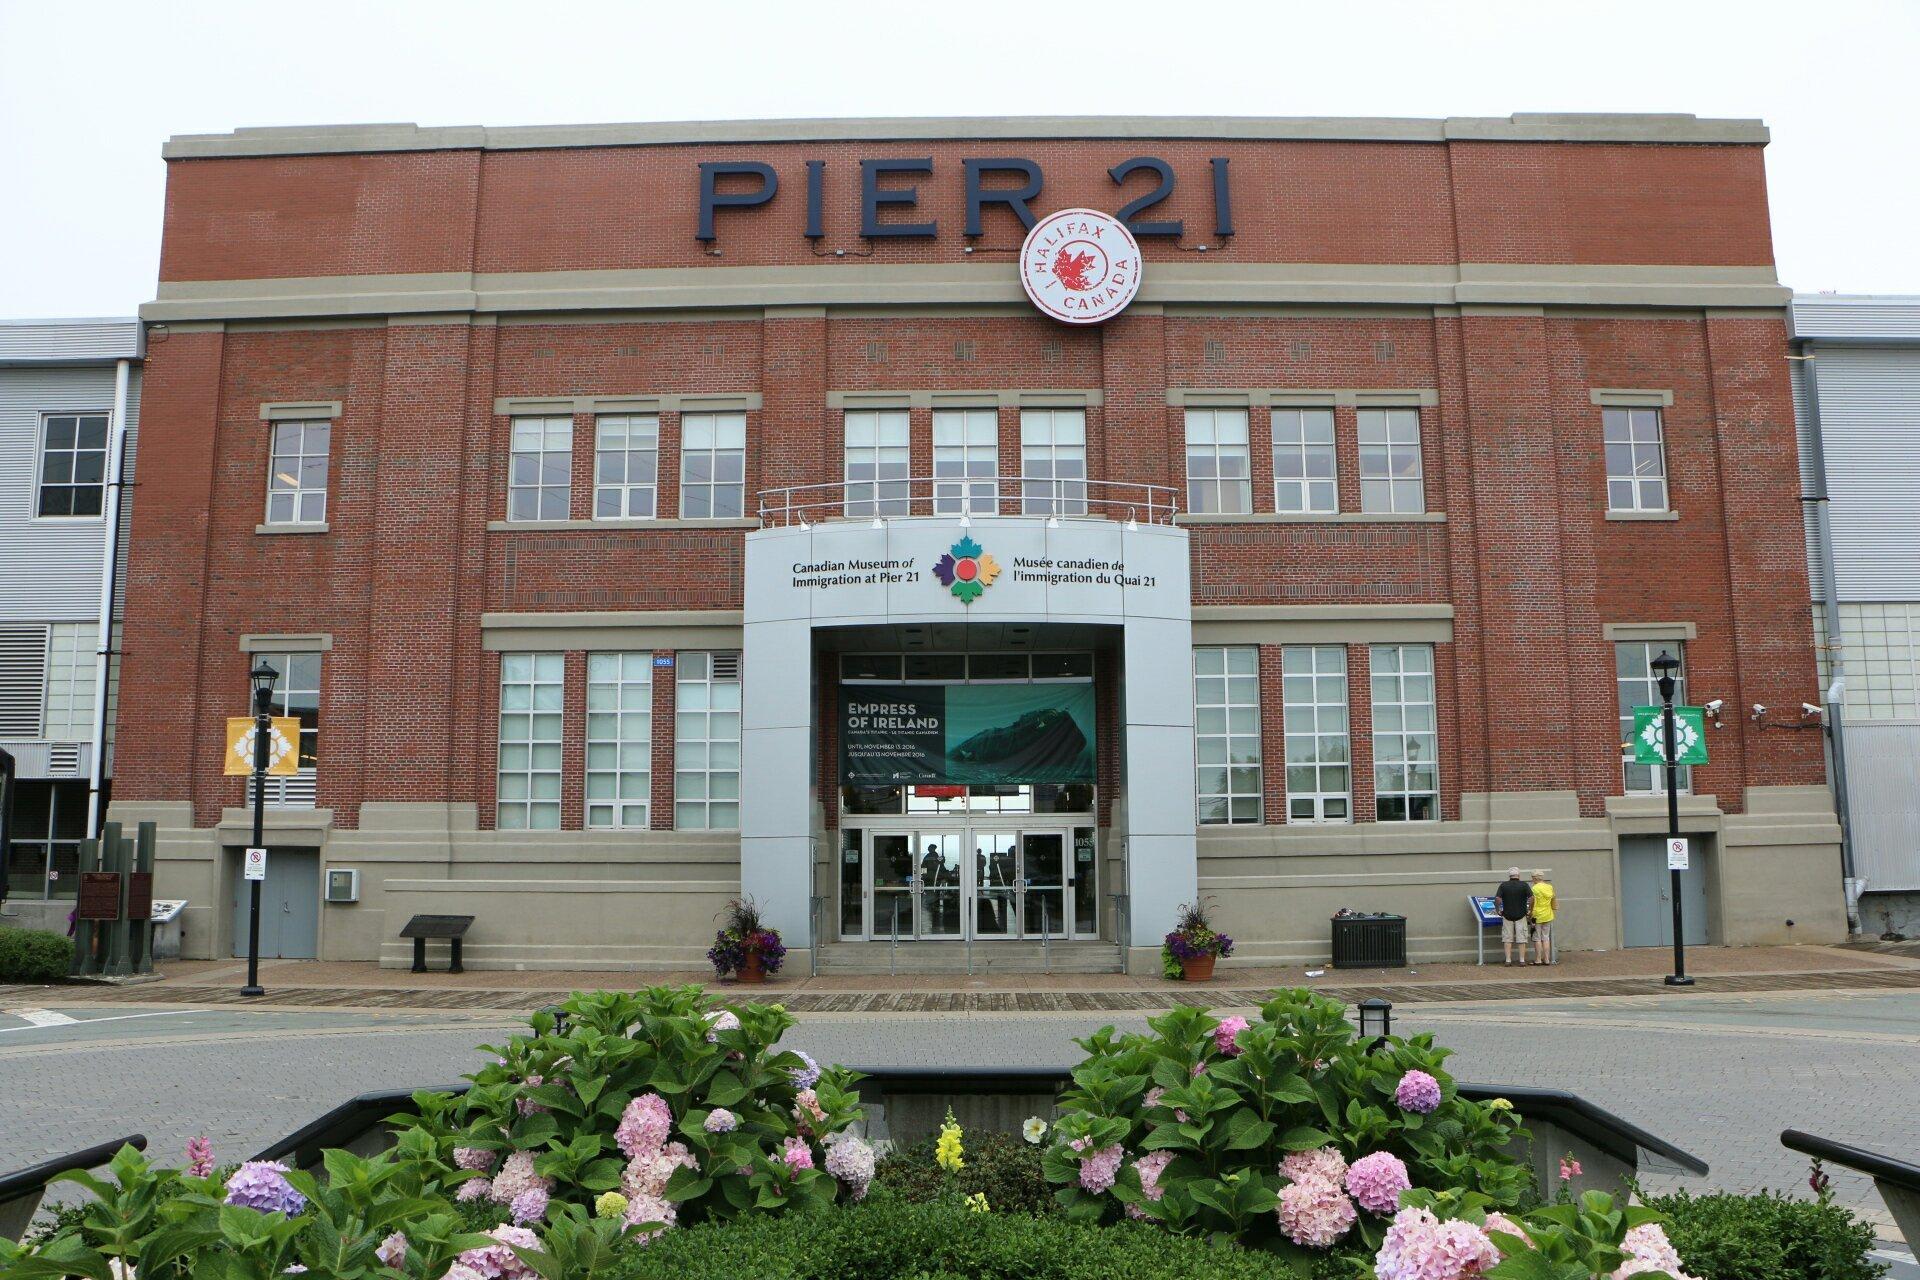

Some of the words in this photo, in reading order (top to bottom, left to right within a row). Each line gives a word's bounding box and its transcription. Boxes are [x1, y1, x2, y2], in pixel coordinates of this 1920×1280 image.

[695, 156, 1044, 241] PIER
[1107, 156, 1236, 237] 21
[1035, 222, 1104, 273] HALIFAX
[1063, 259, 1128, 310] CANADA
[792, 561, 845, 574] Canadian
[848, 559, 899, 570] Museum
[901, 558, 915, 568] of
[1013, 556, 1053, 568] Musée
[1056, 557, 1109, 570] canadien
[1111, 560, 1124, 571] de
[792, 573, 861, 589] Immigration
[864, 573, 876, 584] at
[879, 571, 903, 583] Pier
[906, 571, 920, 582] 21
[1013, 570, 1093, 586] l'immigration
[1096, 573, 1111, 584] du
[1114, 574, 1141, 587] Quai
[1143, 576, 1156, 587] 21
[848, 702, 917, 715] EMPRESS
[848, 716, 869, 728] OF
[873, 717, 939, 729] IRELAND
[1075, 838, 1094, 847] 1055
